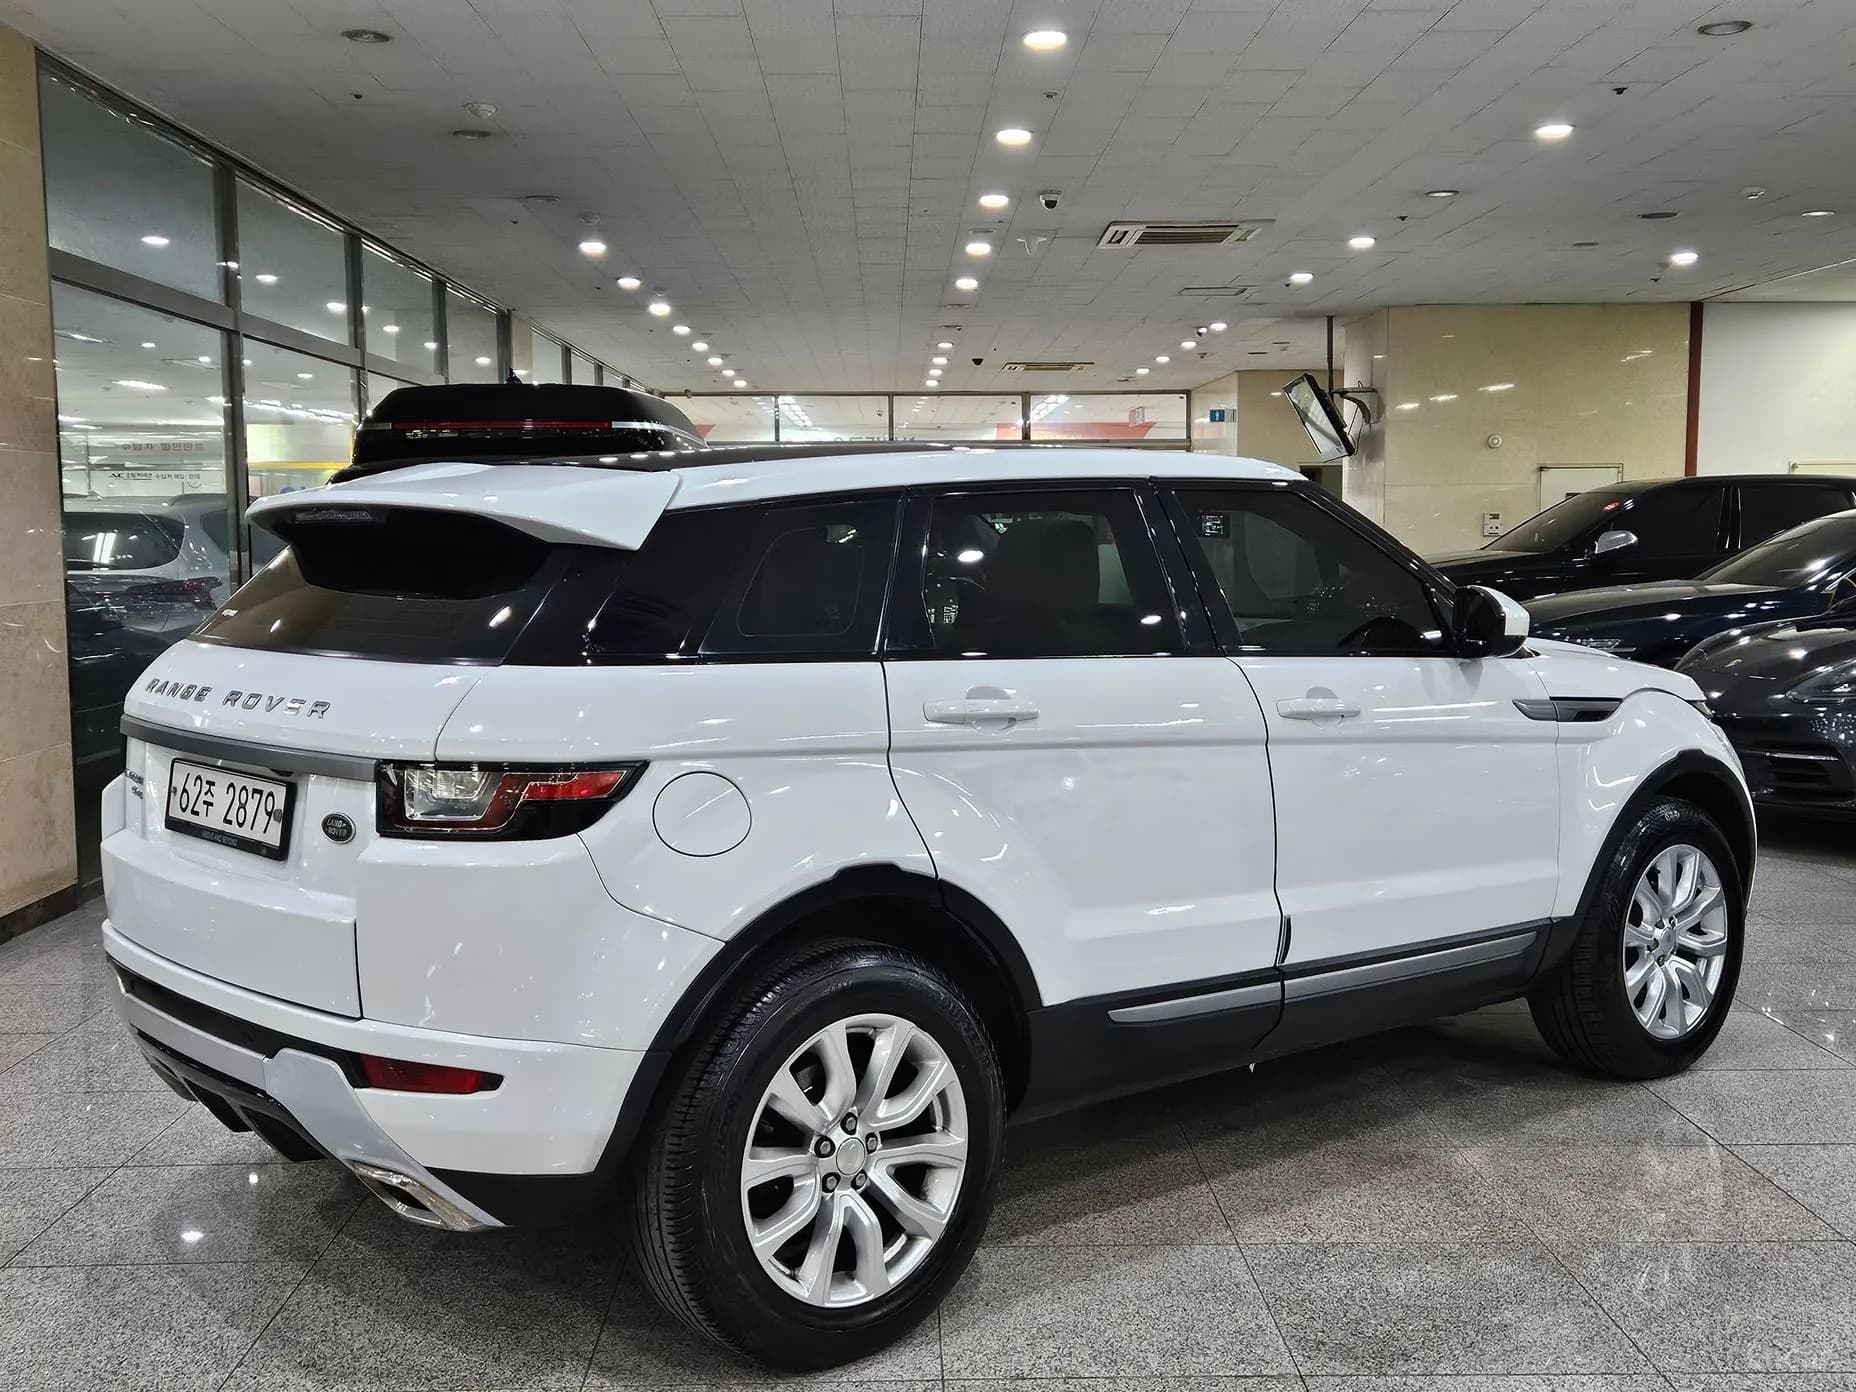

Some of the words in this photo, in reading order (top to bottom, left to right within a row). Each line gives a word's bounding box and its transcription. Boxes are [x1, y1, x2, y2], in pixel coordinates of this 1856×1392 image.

[145, 677, 212, 701] RANGE
[222, 690, 331, 718] ROVER
[179, 772, 216, 818] 62주
[223, 782, 276, 835] 2879
